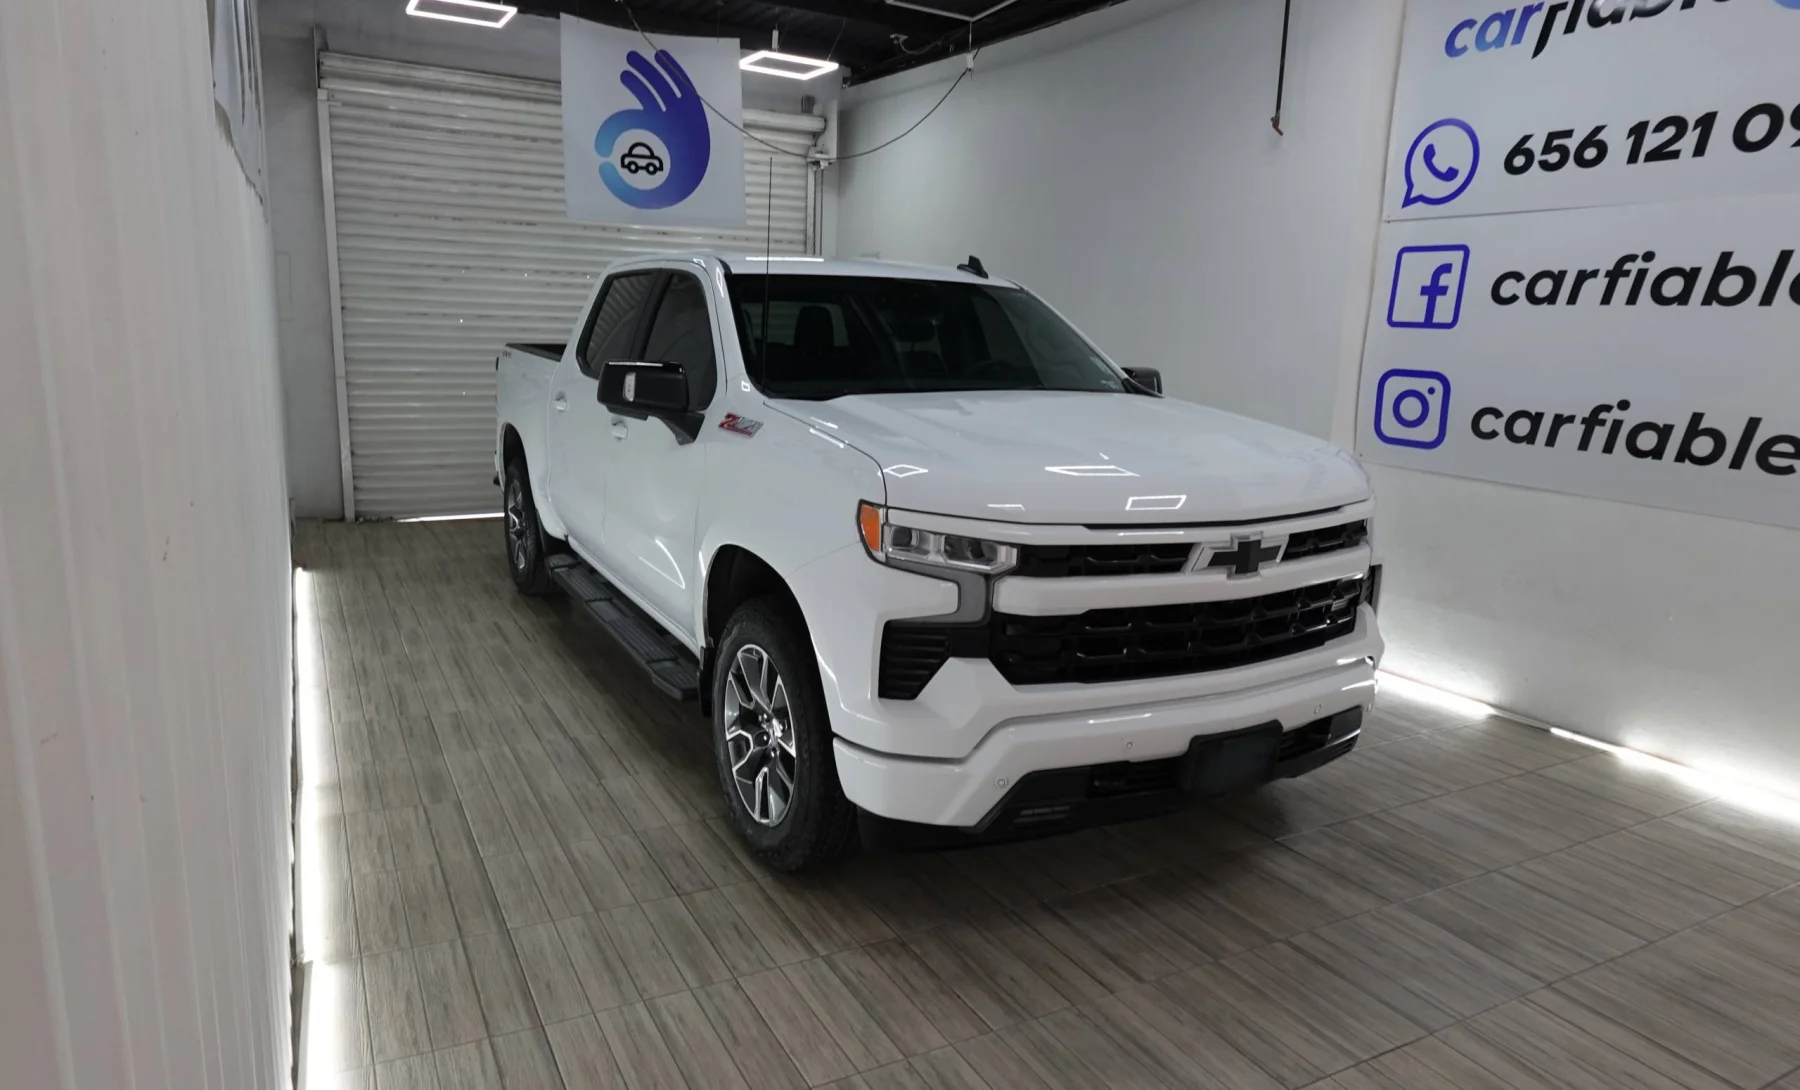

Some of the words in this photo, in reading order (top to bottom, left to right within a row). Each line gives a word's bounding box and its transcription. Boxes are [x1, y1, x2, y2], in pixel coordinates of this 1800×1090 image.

[1503, 124, 1608, 176] 656
[1626, 111, 1718, 165] 121
[1732, 102, 1800, 153] 0
[1490, 249, 1800, 307] carfiabl
[1470, 399, 1800, 476] carfiable
